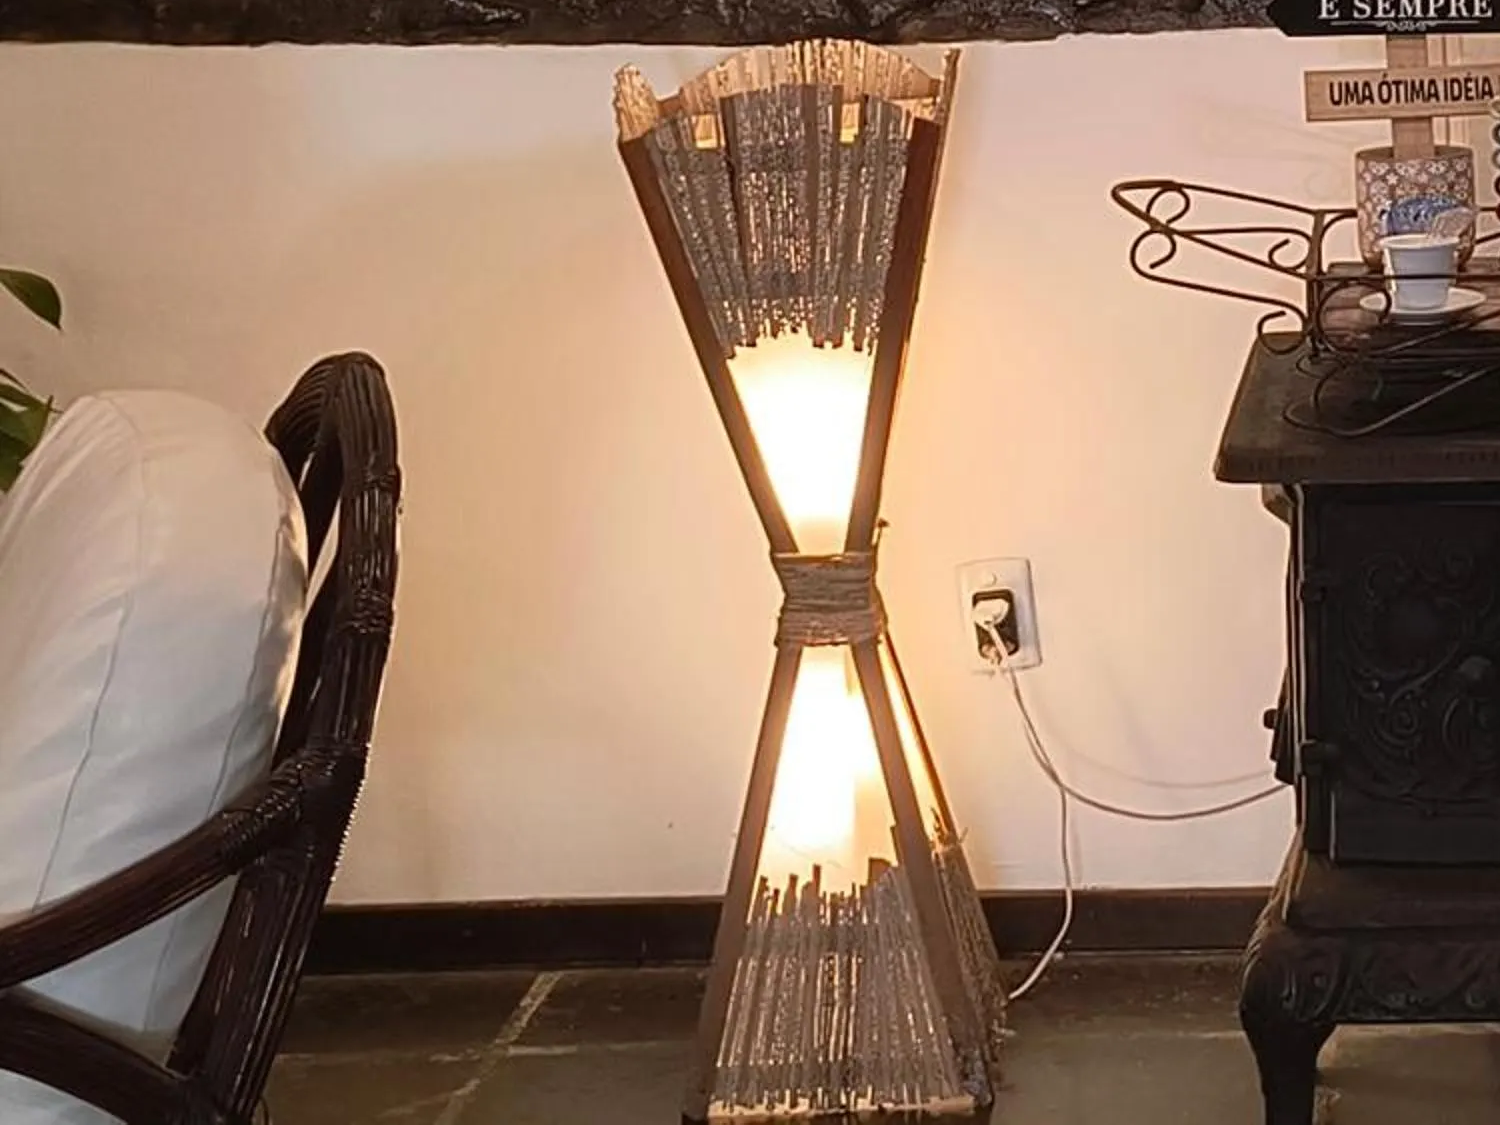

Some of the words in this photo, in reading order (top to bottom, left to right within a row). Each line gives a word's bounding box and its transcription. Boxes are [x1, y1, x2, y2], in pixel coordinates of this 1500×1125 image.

[1328, 79, 1375, 107] UMA
[1376, 70, 1441, 105] ÓTIMA
[1442, 71, 1495, 102] IDÉIA
